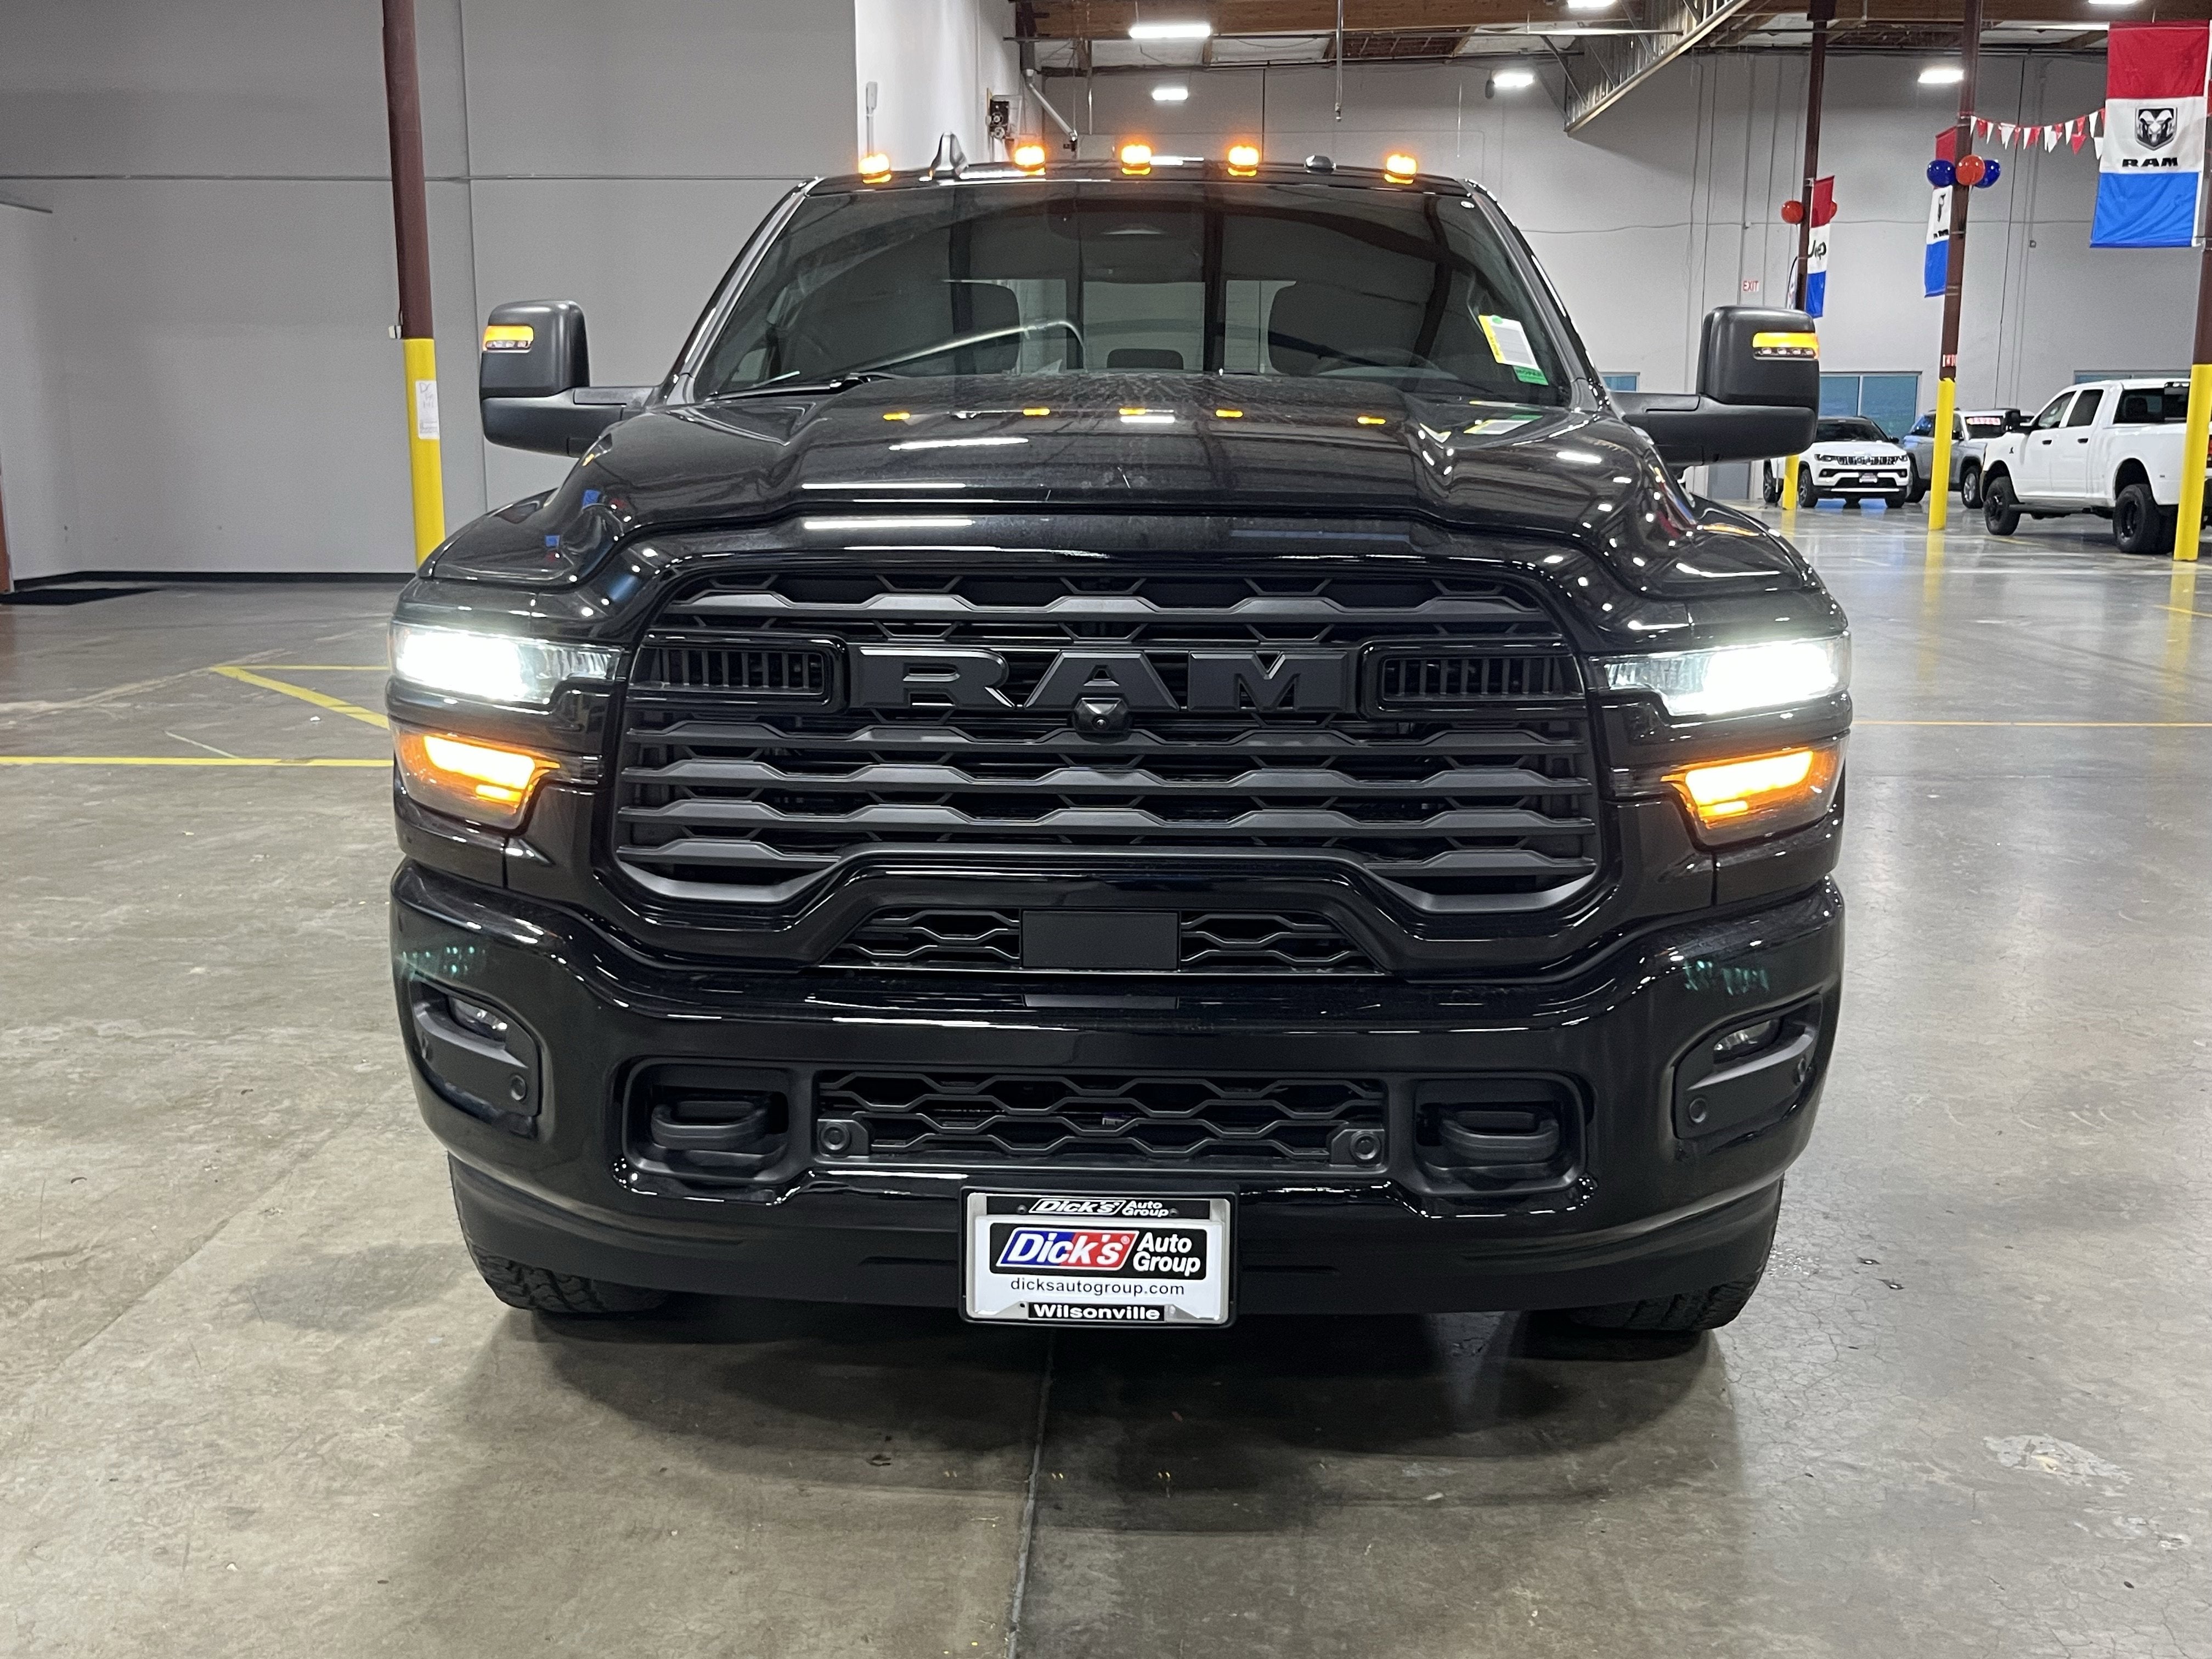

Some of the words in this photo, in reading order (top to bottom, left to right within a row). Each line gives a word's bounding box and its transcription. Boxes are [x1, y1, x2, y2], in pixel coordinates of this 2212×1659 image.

[2122, 157, 2178, 168] RAM
[1743, 281, 1759, 292] EXIT
[858, 646, 1347, 713] RAM
[1035, 1200, 1115, 1214] Dick's
[1122, 1207, 1169, 1217] Group
[1127, 1200, 1163, 1209] Auto
[1007, 1232, 1124, 1265] Dick's
[1137, 1232, 1192, 1254] Auto
[1133, 1251, 1201, 1277] Group
[1011, 1278, 1185, 1296] dicksautogroup.com
[1033, 1304, 1160, 1320] Wilsonville
